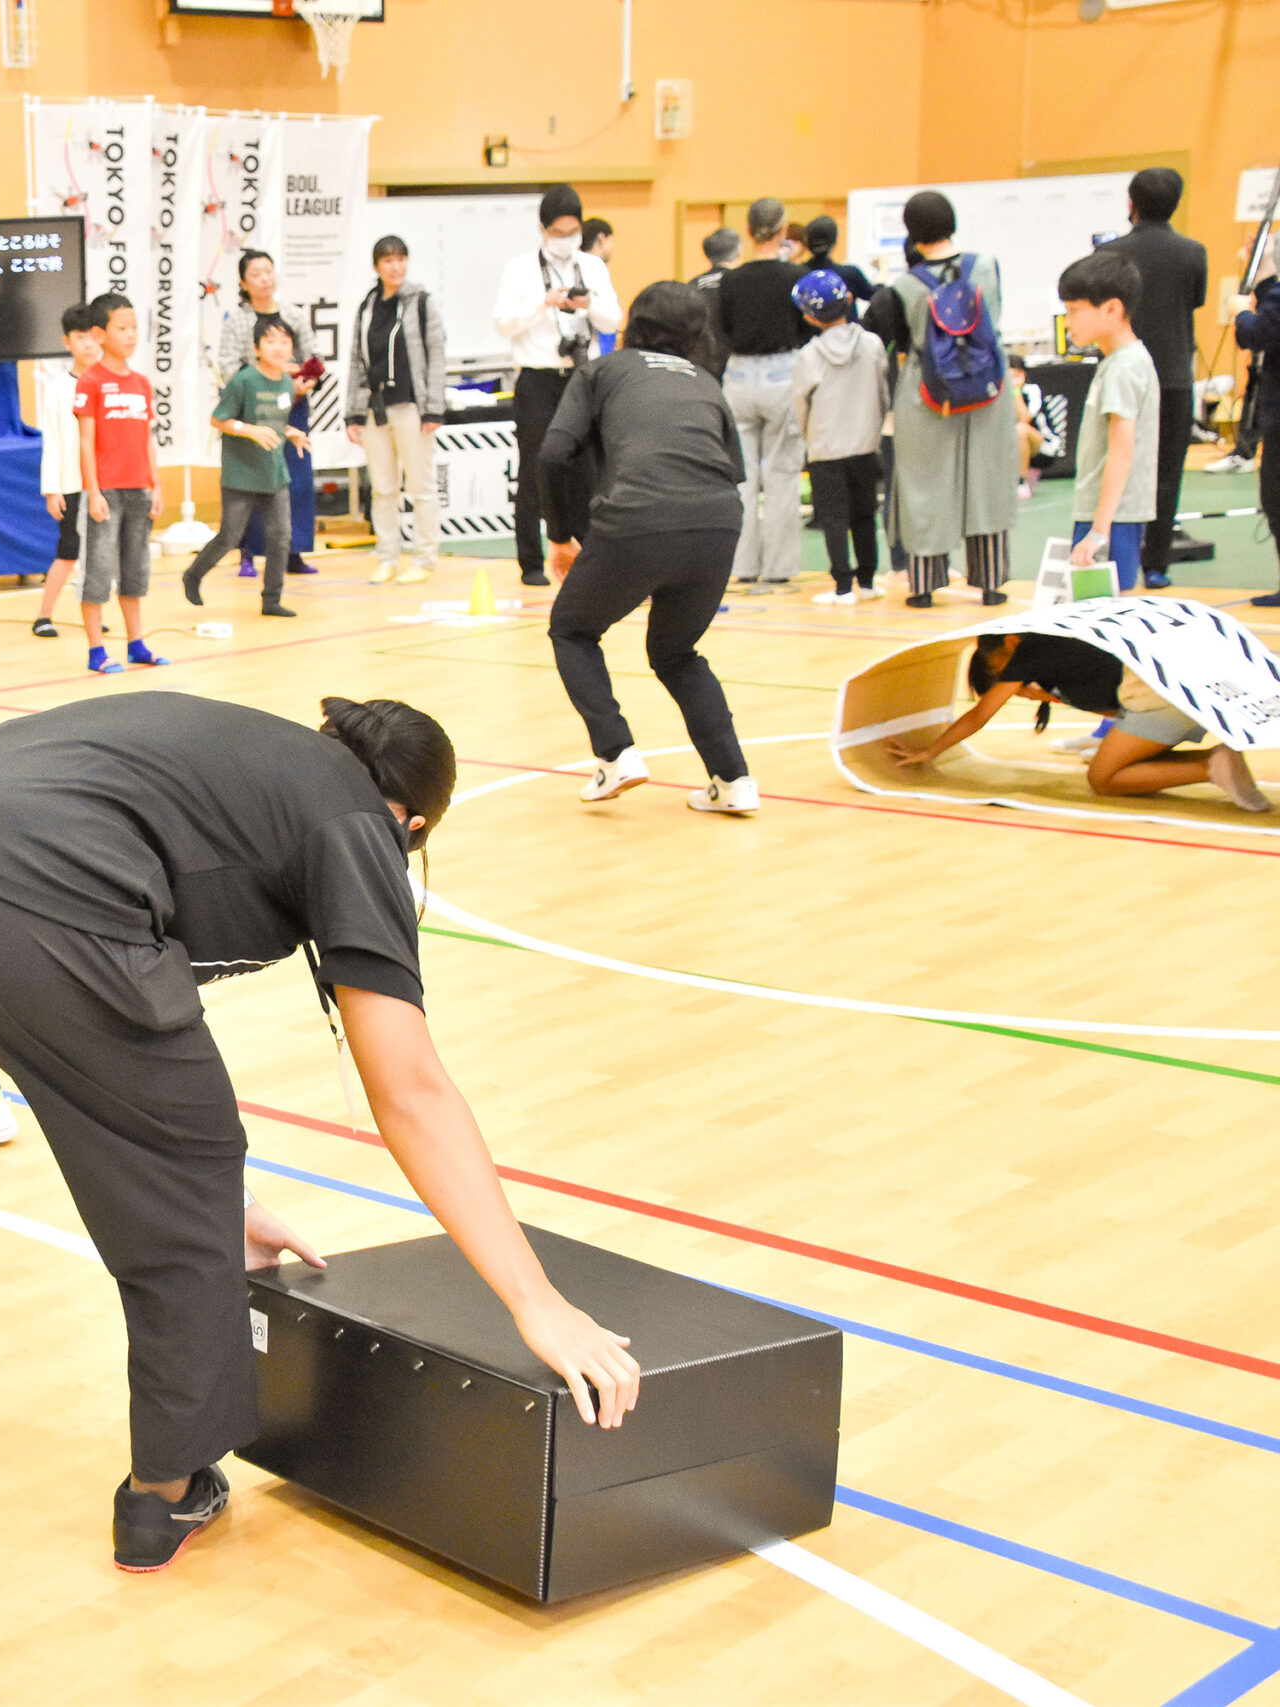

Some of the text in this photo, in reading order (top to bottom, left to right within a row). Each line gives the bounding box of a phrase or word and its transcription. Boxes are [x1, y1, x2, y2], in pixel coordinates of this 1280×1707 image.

[105, 126, 124, 226] TOKYO
[240, 139, 259, 232] TOKYO
[286, 174, 322, 193] BOU.
[286, 197, 343, 216] LEAGUE
[155, 134, 178, 447] TOKYO FORWARD 2025
